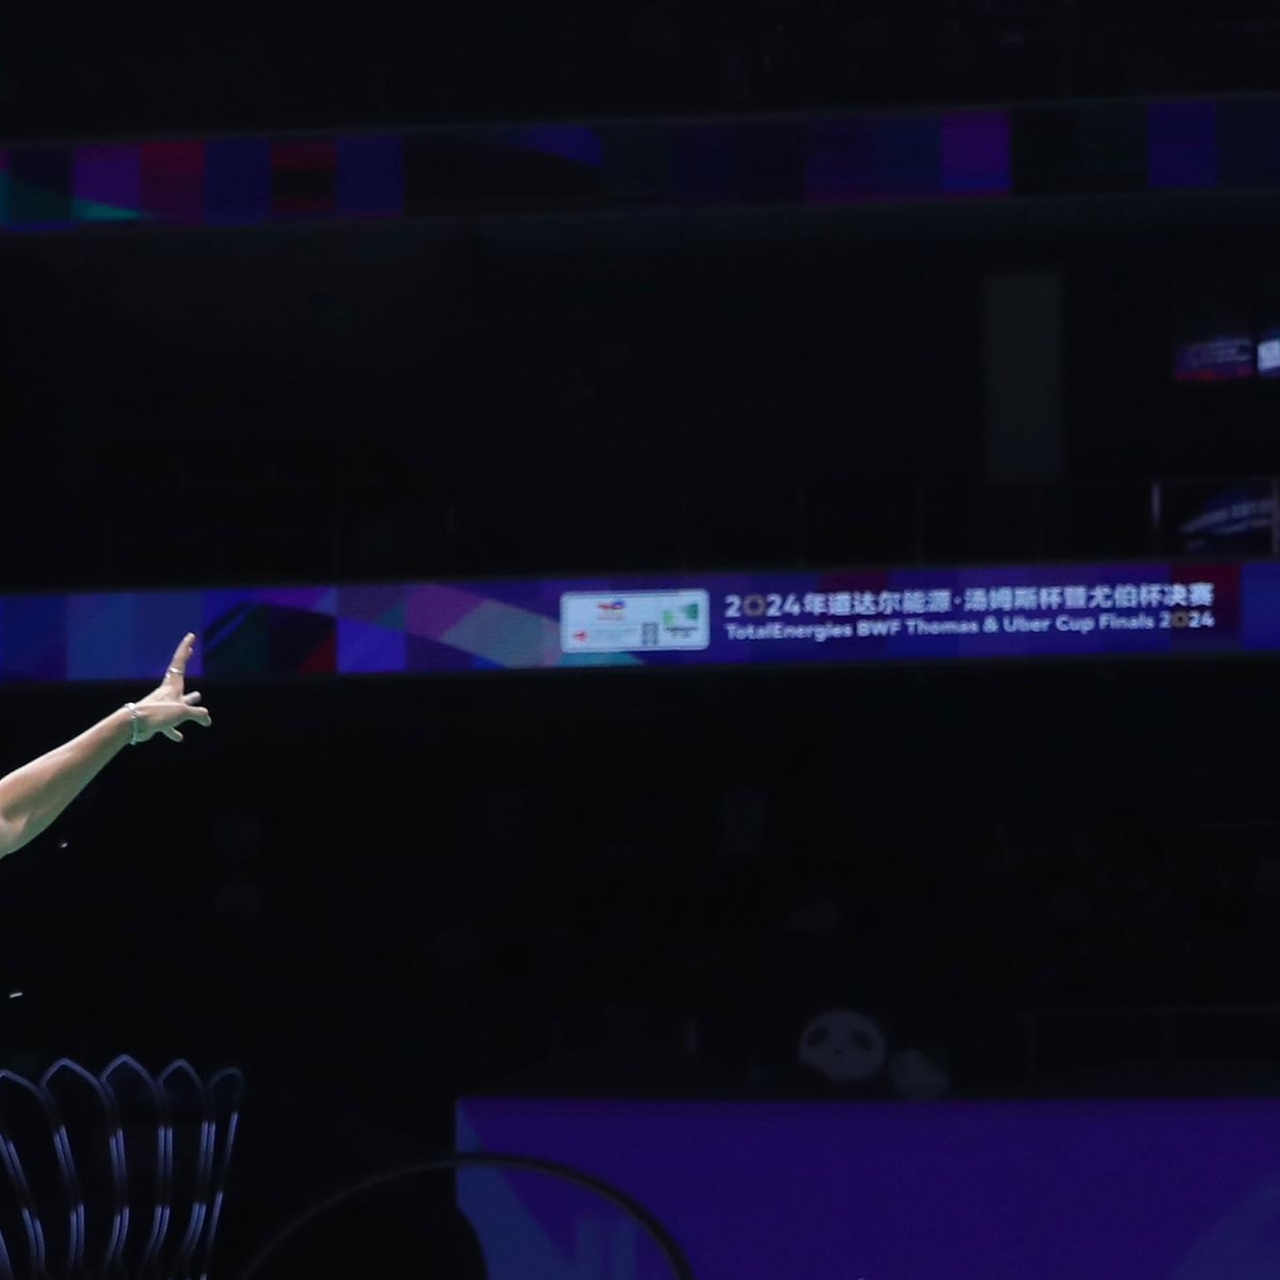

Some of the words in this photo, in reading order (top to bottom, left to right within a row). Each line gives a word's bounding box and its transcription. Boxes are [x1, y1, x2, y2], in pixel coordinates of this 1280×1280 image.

[726, 621, 853, 642] TotalEnergies
[856, 619, 902, 637] BWF
[906, 617, 979, 635] Thomas
[982, 615, 999, 633] &
[1003, 614, 1052, 633] Uber
[1055, 613, 1096, 635] Cup
[1098, 612, 1155, 630] Finals
[1158, 610, 1215, 629] 2024
